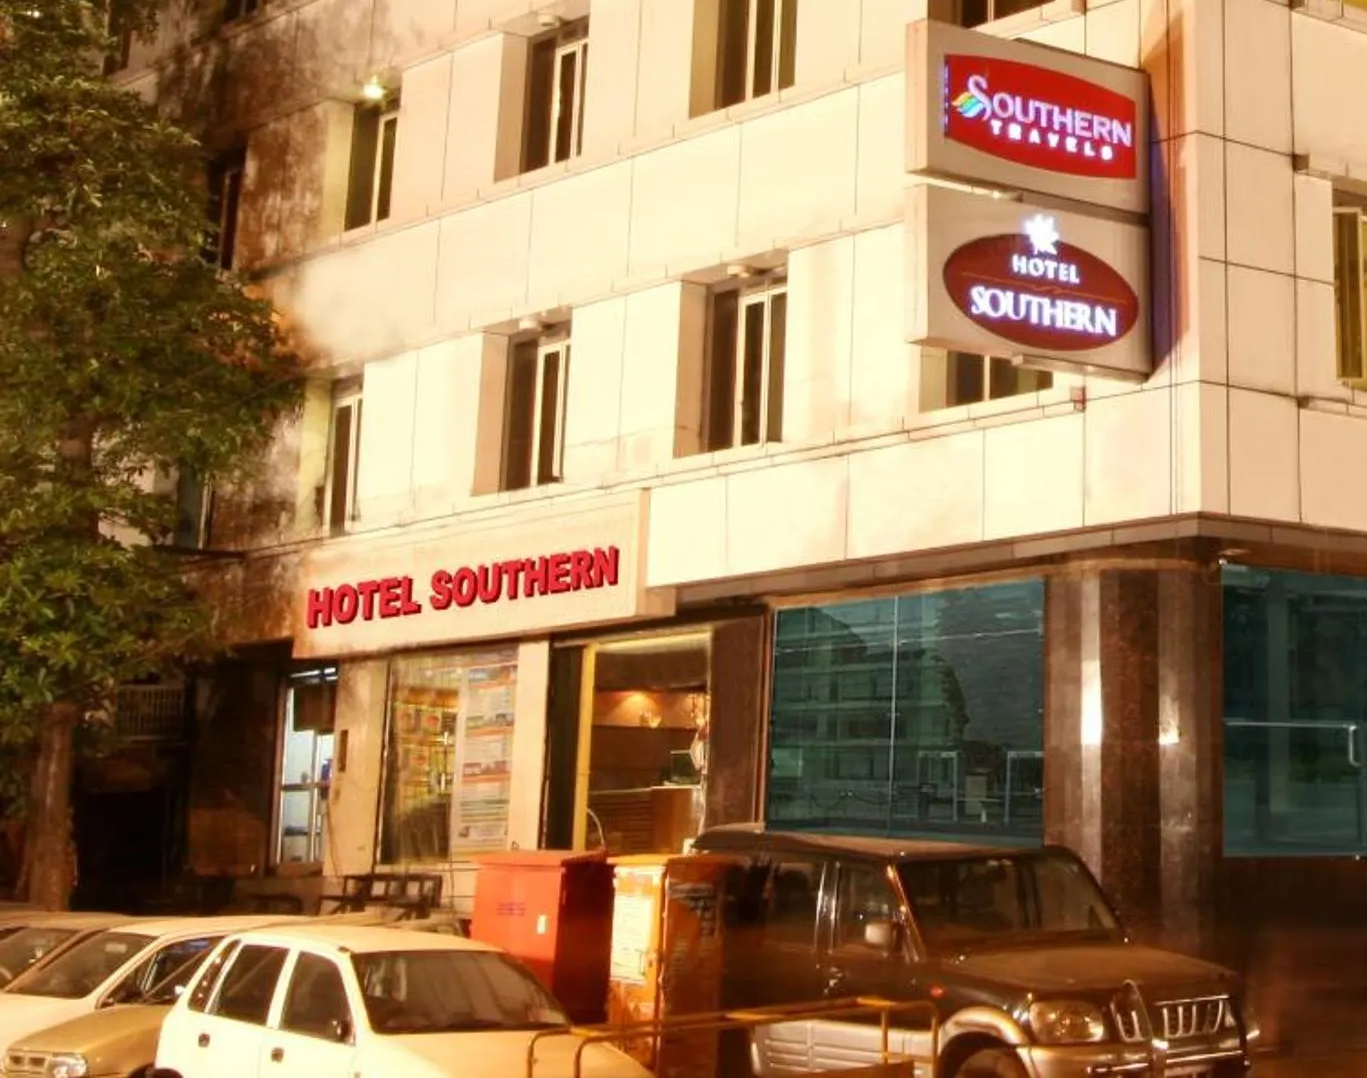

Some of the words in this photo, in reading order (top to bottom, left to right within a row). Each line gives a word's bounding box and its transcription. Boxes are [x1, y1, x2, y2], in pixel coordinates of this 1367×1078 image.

[956, 75, 1132, 147] SOUTHERN
[991, 119, 1113, 160] TRAVELS
[1012, 254, 1080, 284] HOTEL
[970, 285, 1117, 336] SOUTHERN
[307, 575, 420, 628] HOTEL
[430, 545, 619, 610] SOUTHERN
